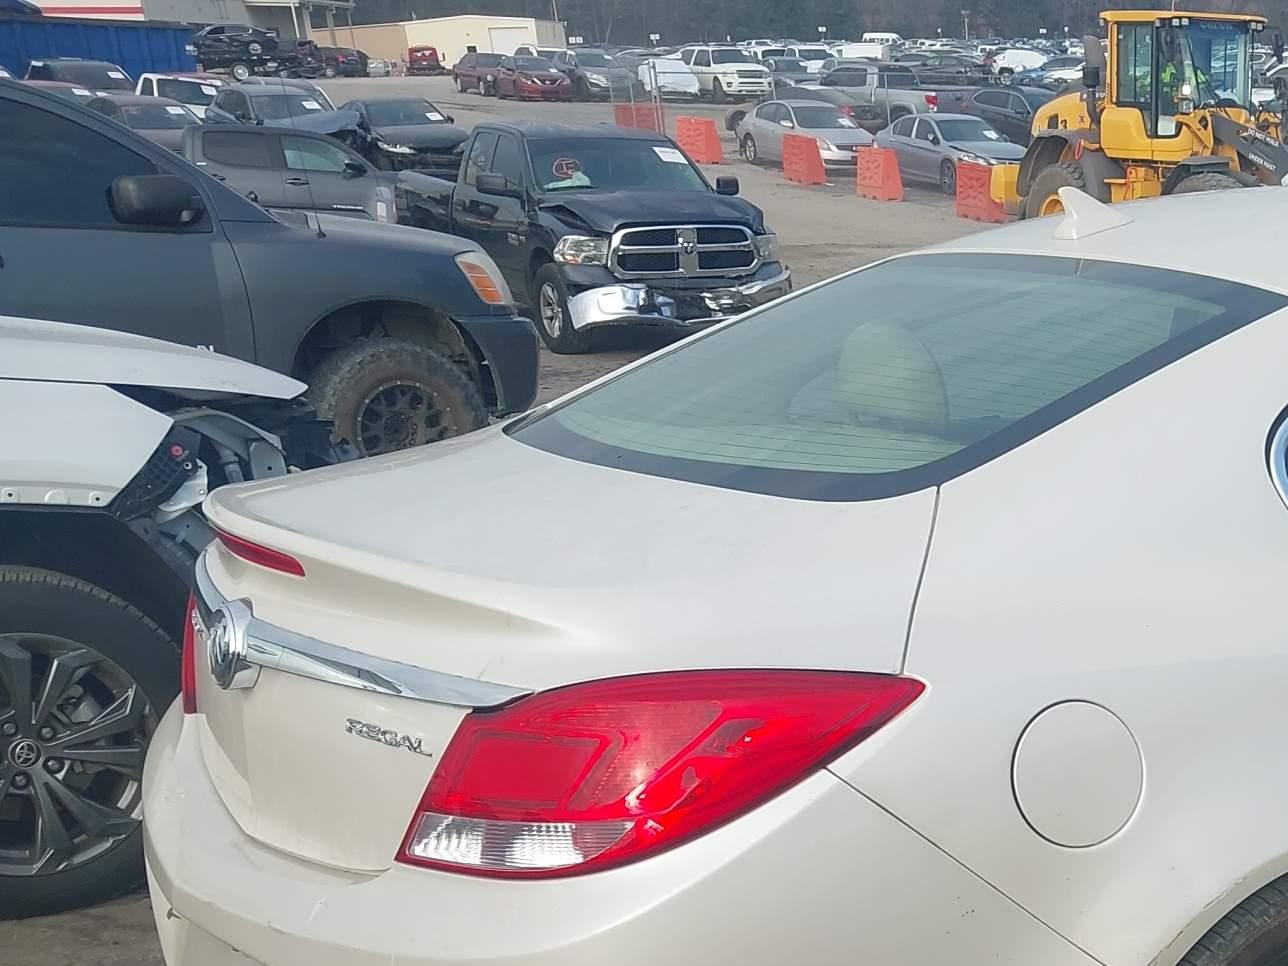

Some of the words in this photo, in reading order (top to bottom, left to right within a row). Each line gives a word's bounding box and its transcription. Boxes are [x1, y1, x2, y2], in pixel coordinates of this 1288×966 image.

[1200, 22, 1232, 30] VOLVO
[1255, 132, 1266, 141] NOT
[1265, 136, 1279, 147] WALK
[1248, 152, 1264, 165] UNDER
[345, 718, 432, 758] REGAL
